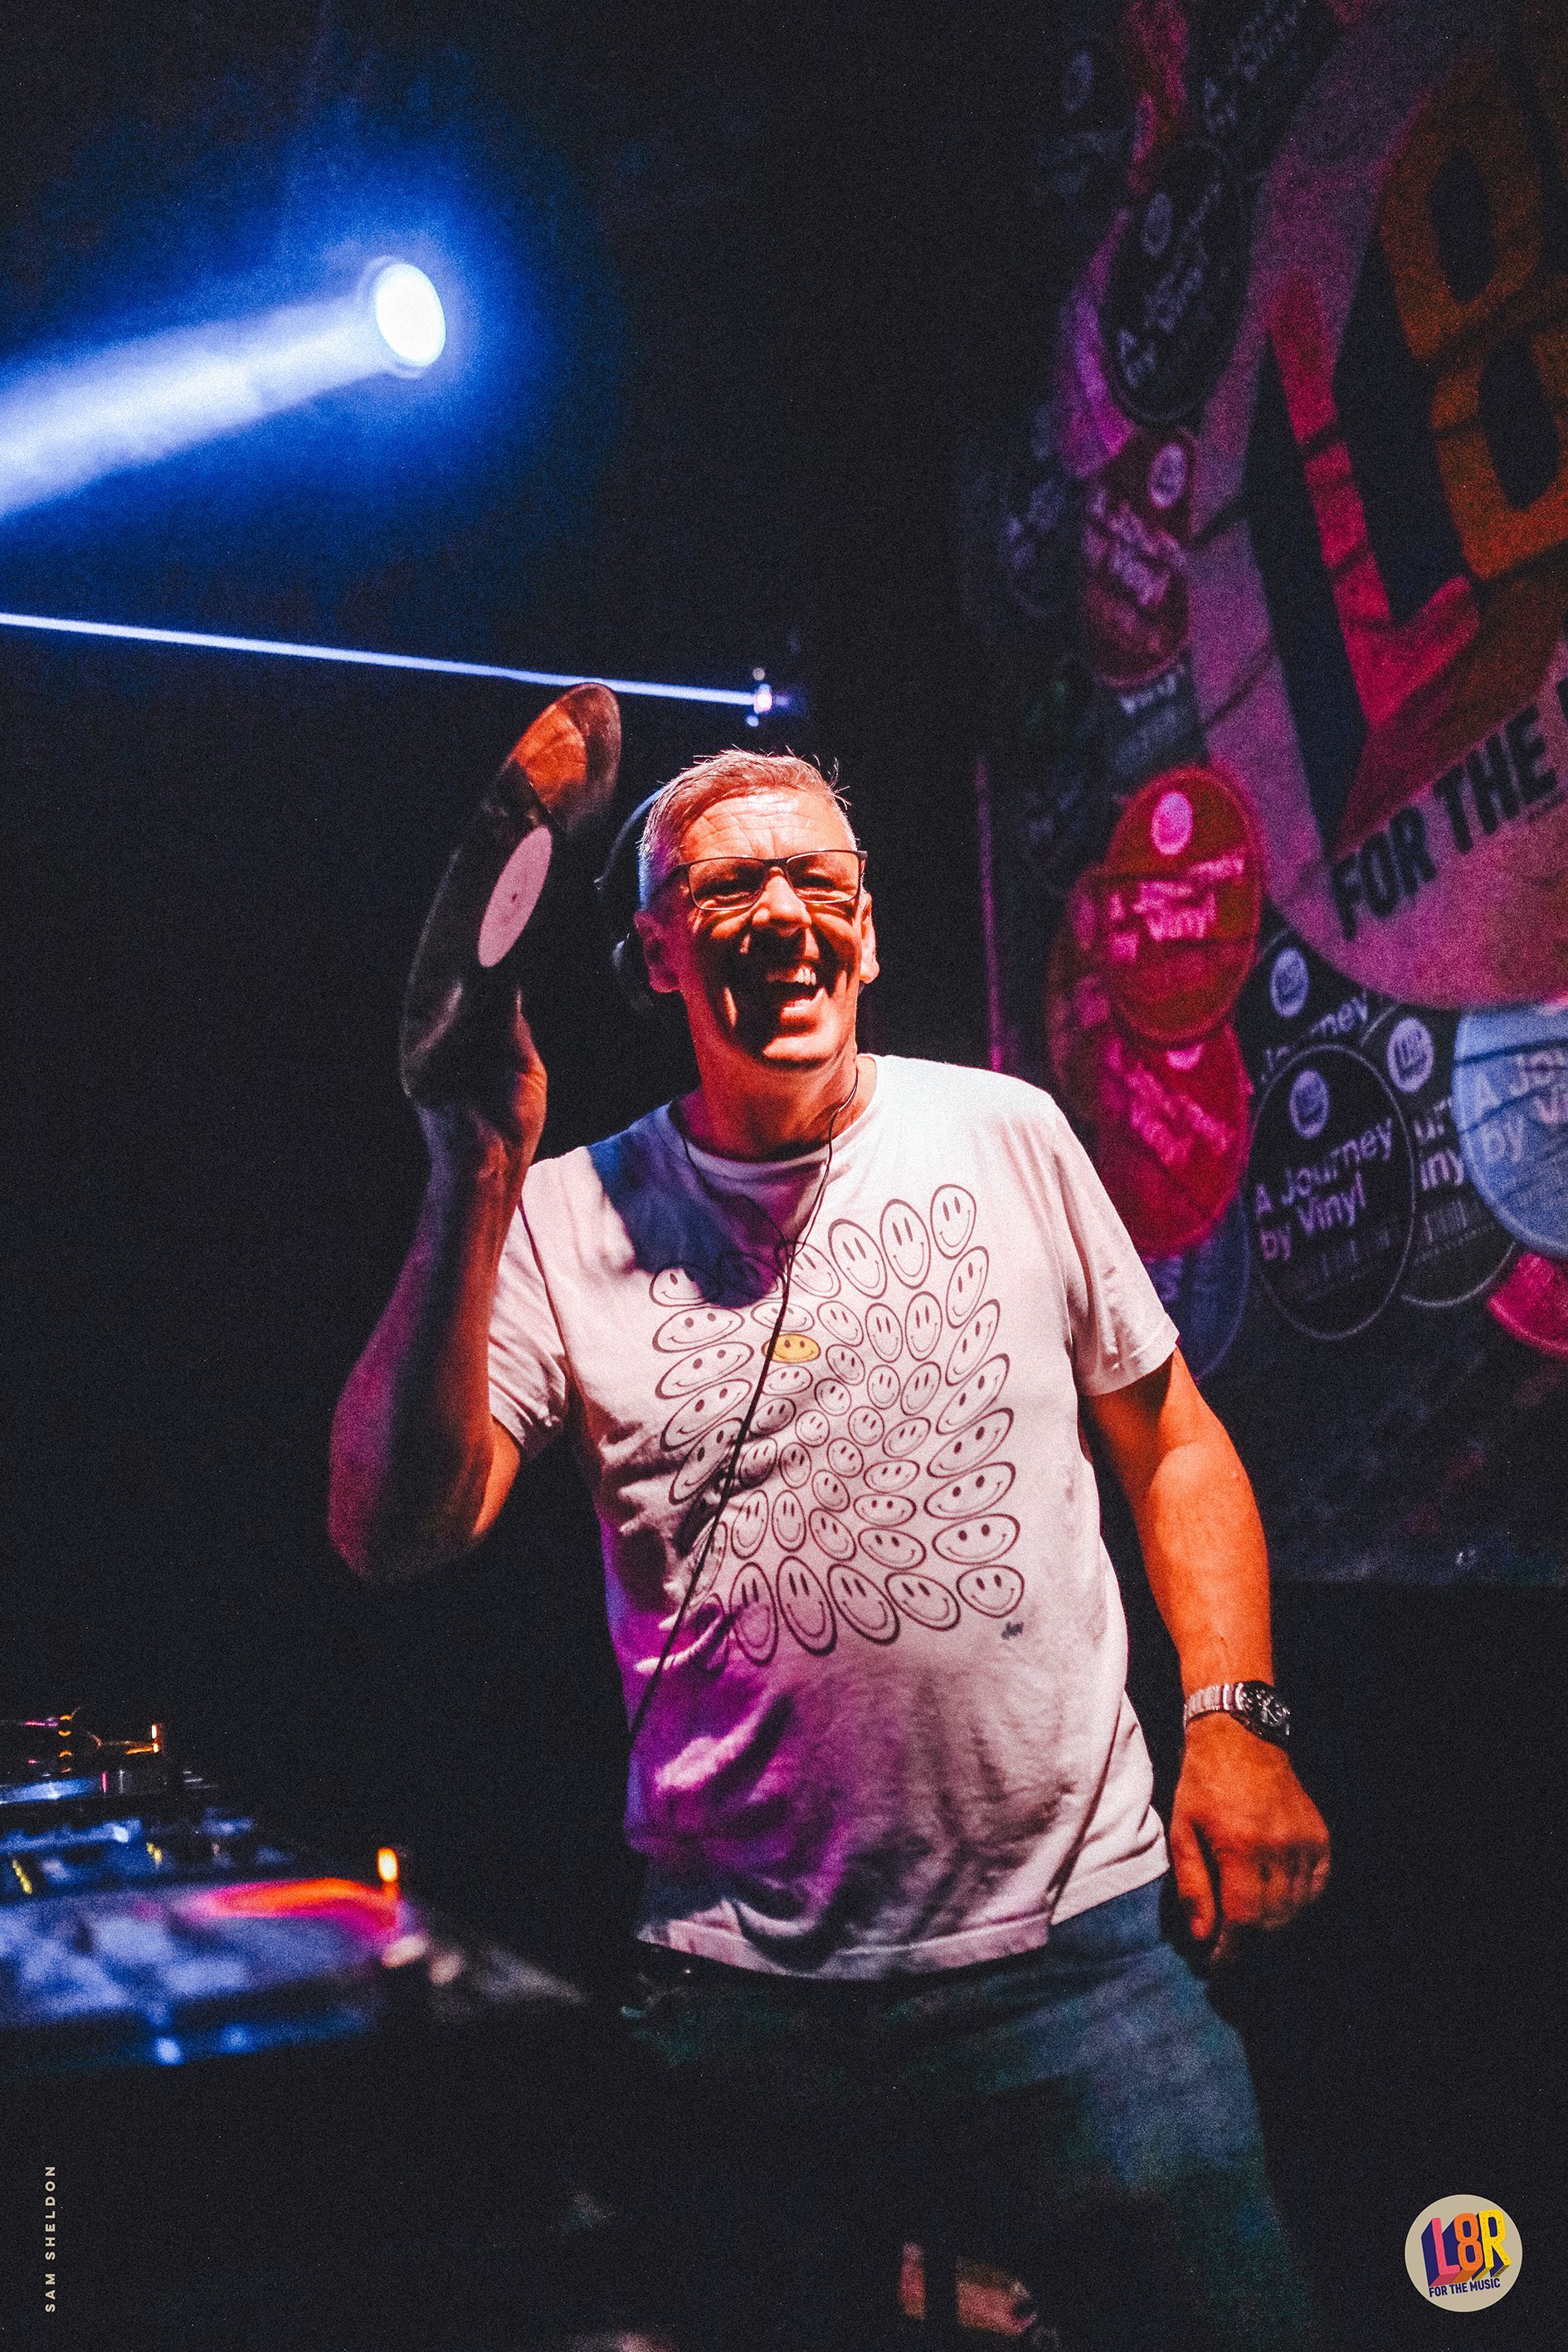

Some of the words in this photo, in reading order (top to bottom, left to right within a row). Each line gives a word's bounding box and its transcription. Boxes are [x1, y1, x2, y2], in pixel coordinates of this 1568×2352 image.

[1332, 806, 1437, 942] FOR
[1433, 707, 1557, 855] THE
[1254, 1183, 1273, 1221] A
[1280, 1117, 1392, 1205] Journey
[1259, 1223, 1292, 1262] by
[1296, 1171, 1366, 1236] Vinyl
